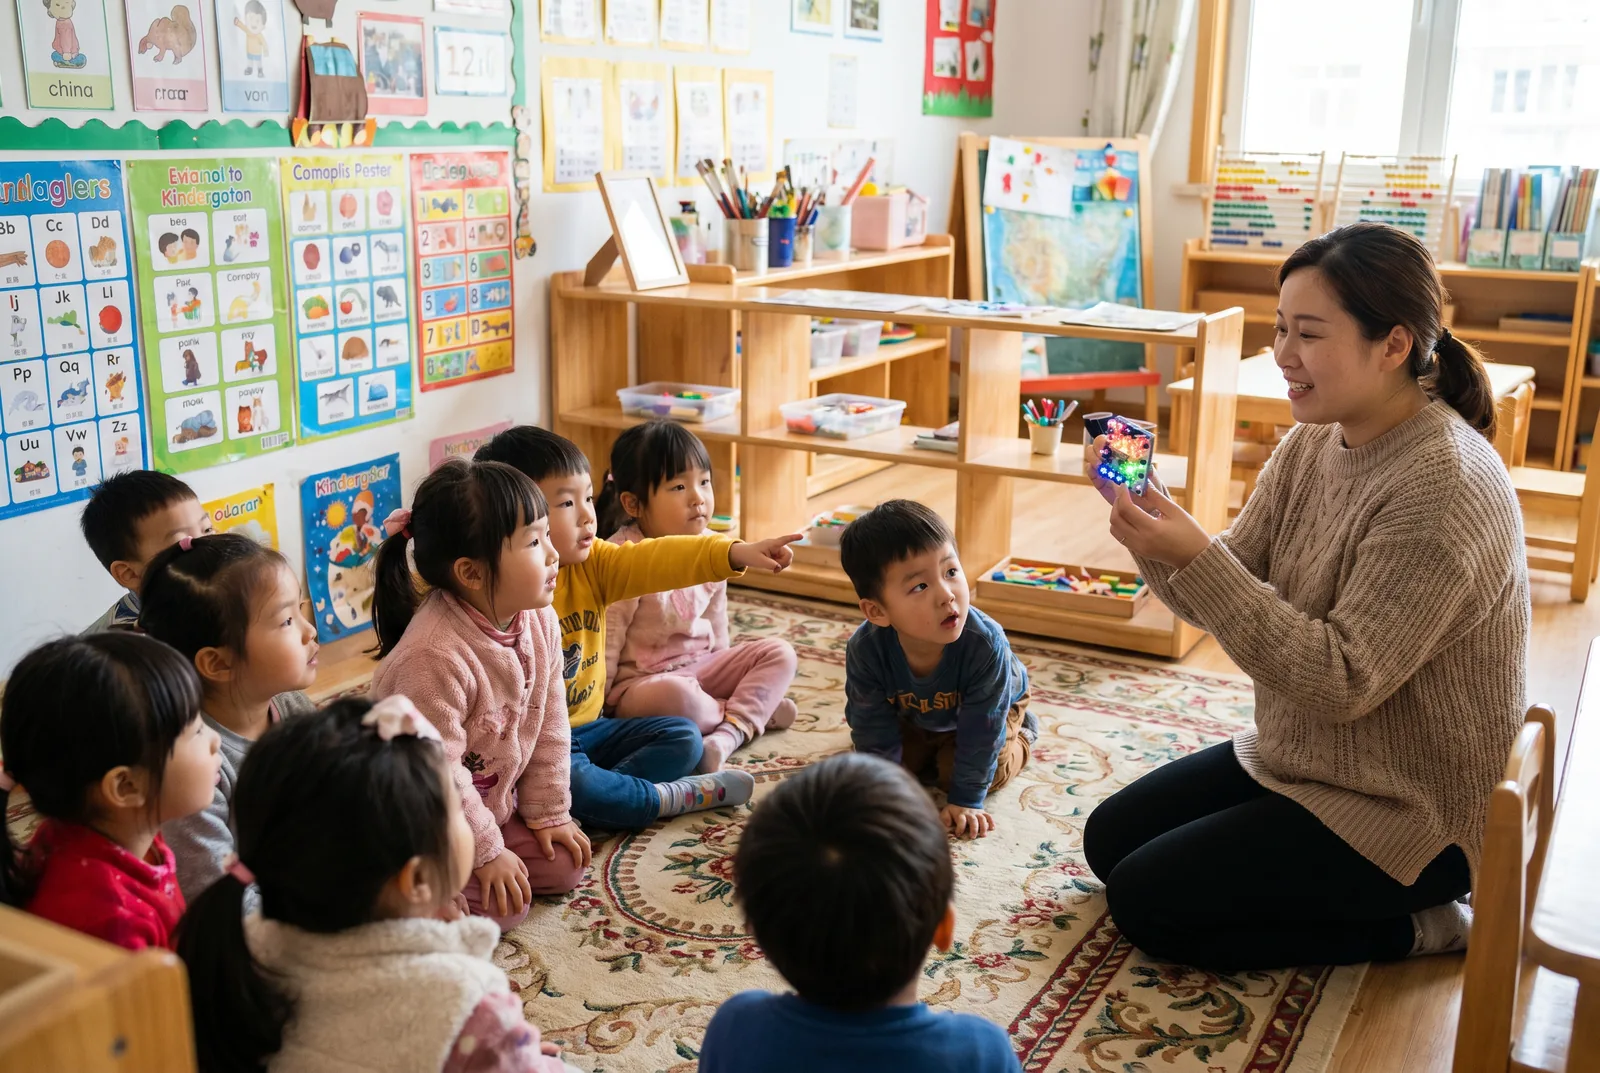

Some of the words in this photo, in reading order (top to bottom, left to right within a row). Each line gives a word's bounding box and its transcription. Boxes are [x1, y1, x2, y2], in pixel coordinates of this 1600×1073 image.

[48, 80, 94, 98] china
[228, 165, 243, 182] to
[466, 193, 475, 210] 2
[45, 218, 64, 232] Cc
[91, 215, 110, 229] Dd
[421, 229, 430, 246] 2
[468, 226, 476, 241] 4
[423, 262, 431, 279] 3
[470, 256, 478, 273] 6
[55, 290, 71, 304] Jk
[425, 294, 433, 311] 5
[470, 287, 479, 304] 8
[427, 327, 434, 344] 7
[59, 360, 80, 375] Qq
[106, 354, 121, 366] Rr
[13, 367, 32, 383] Pp
[65, 429, 87, 442] Vw
[111, 421, 128, 434] Zz
[19, 438, 40, 452] Uu
